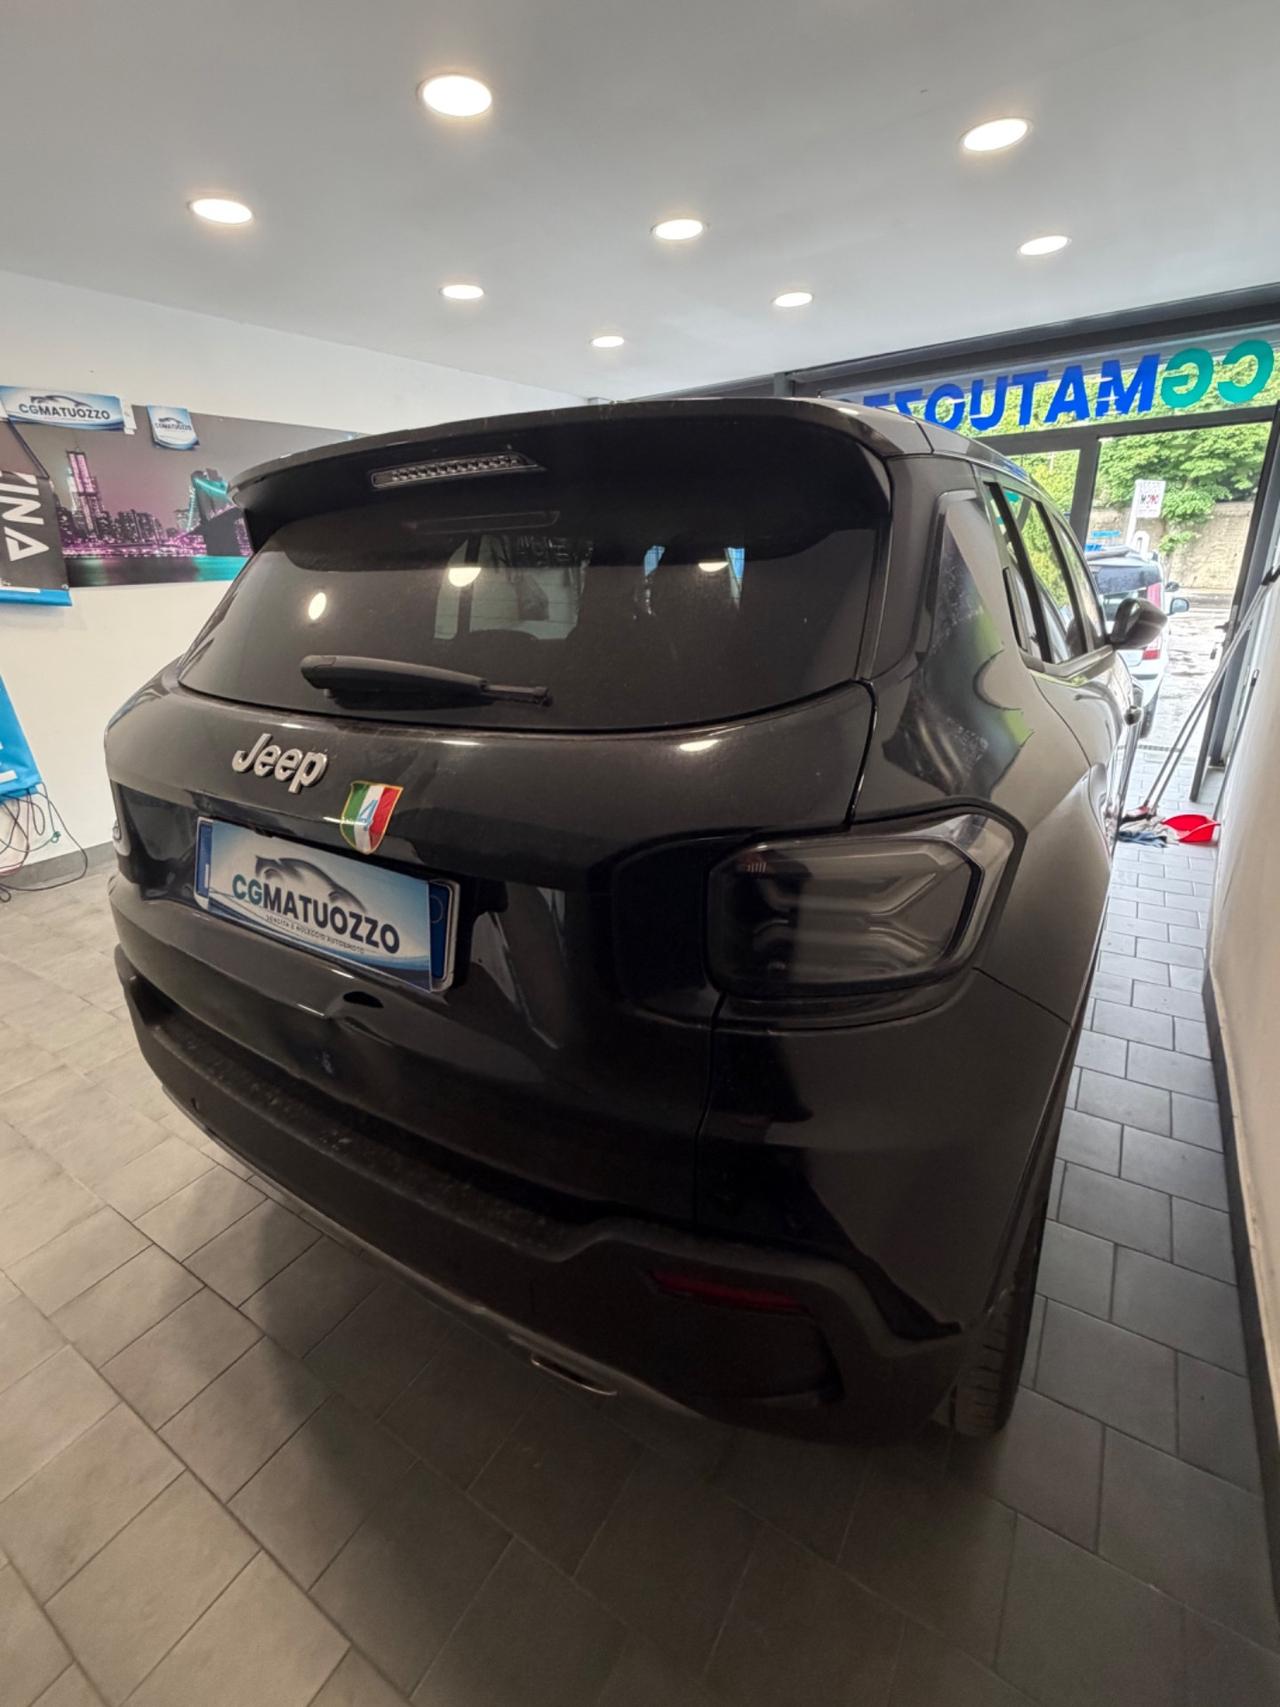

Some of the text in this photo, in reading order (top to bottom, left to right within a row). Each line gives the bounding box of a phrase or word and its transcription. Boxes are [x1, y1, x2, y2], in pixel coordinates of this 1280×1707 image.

[18, 403, 111, 420] CGMATUOZZO
[231, 732, 329, 794] Jeep
[231, 873, 400, 954] CGMATUOZZO
